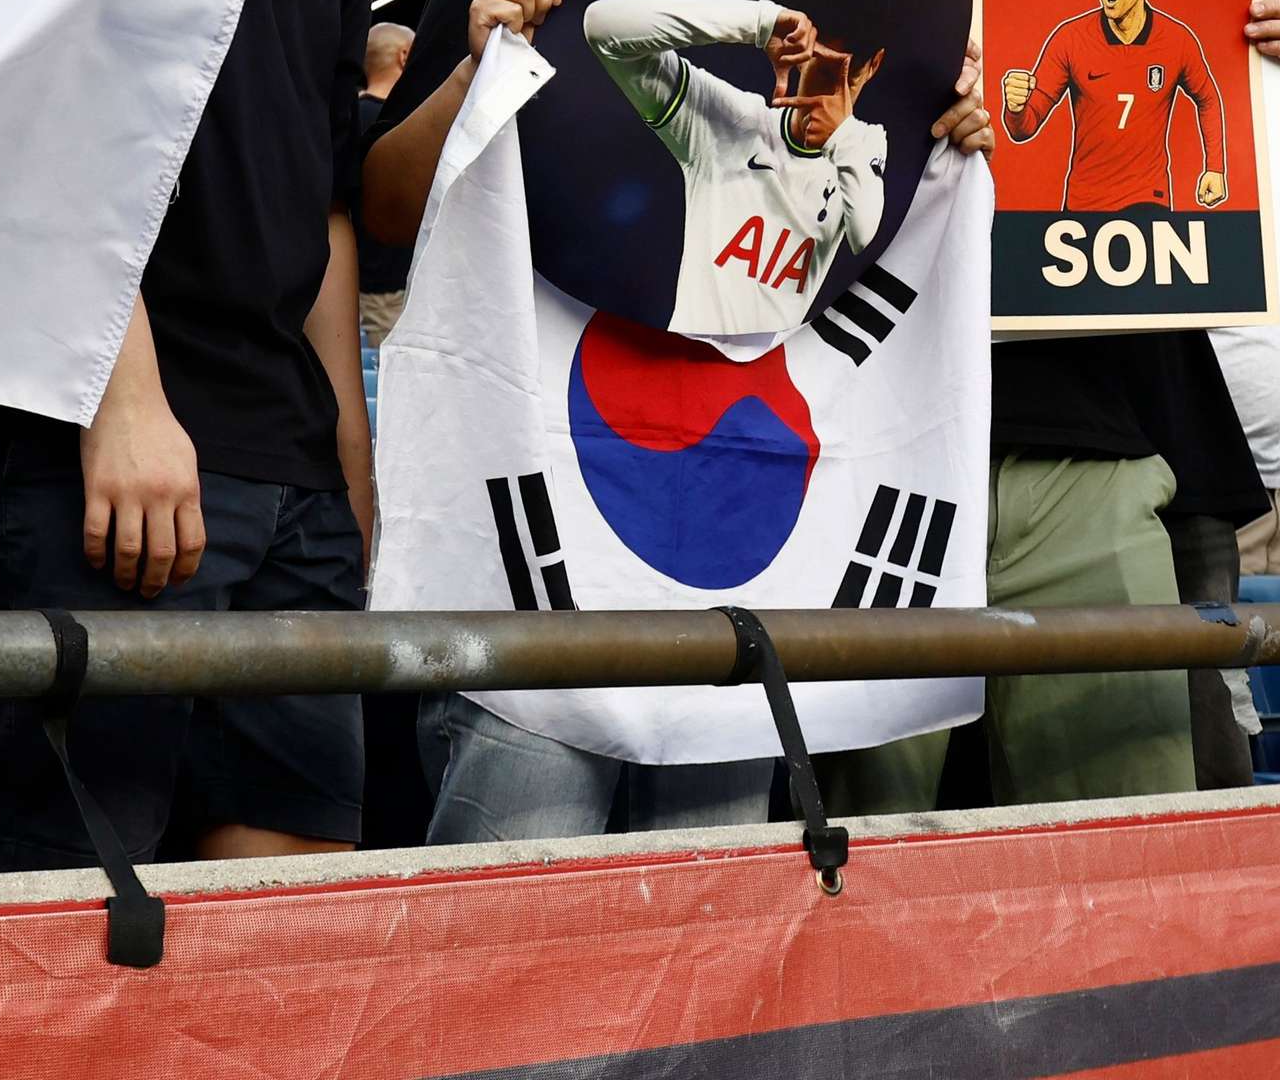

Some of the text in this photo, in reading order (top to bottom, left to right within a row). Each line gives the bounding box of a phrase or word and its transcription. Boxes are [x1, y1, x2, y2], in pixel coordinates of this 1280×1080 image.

[1117, 93, 1135, 129] 7
[713, 215, 816, 294] AIA
[1041, 219, 1209, 288] SON
